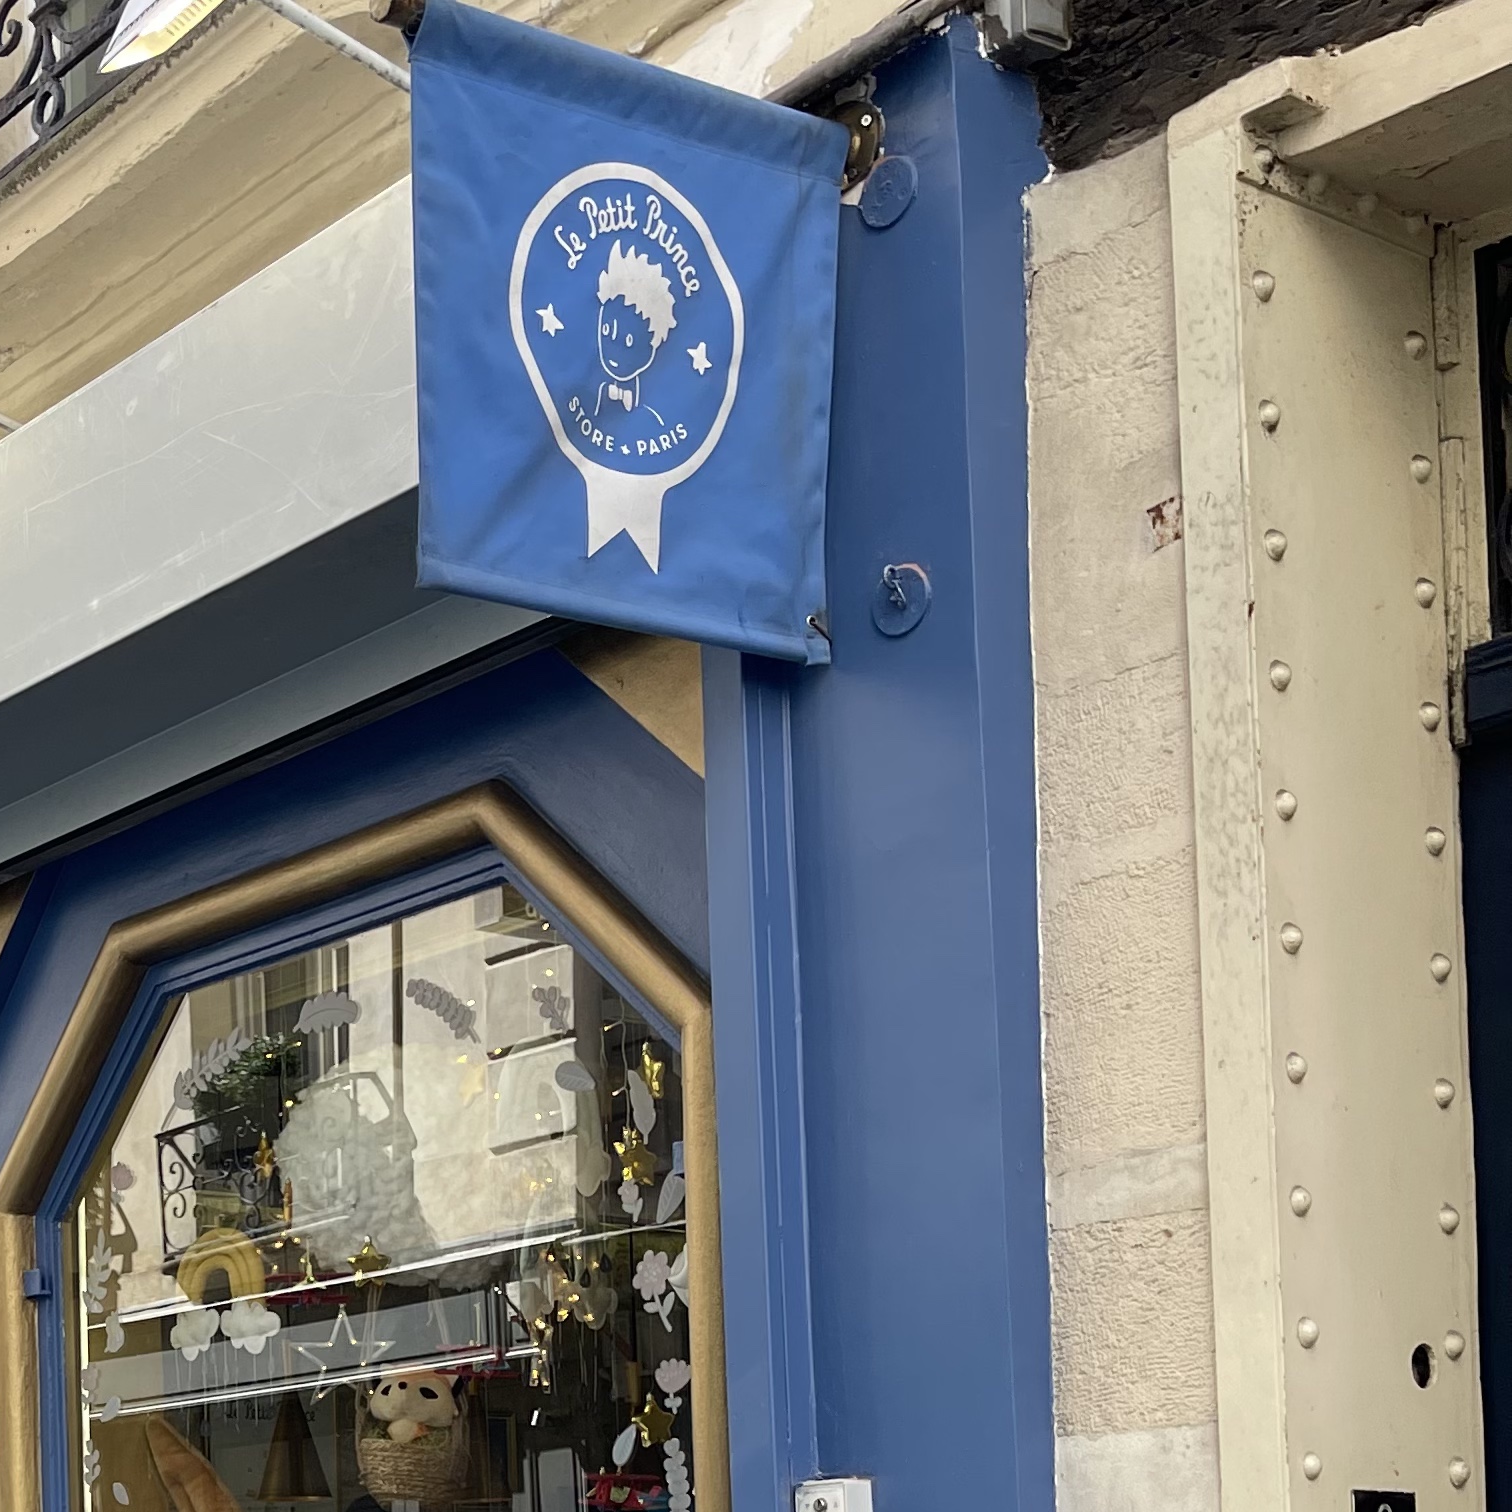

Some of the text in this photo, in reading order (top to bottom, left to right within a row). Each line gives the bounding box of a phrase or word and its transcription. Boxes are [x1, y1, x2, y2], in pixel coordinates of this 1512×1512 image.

[554, 192, 700, 297] Le Petit Prince
[569, 396, 688, 456] STORE PARIS
